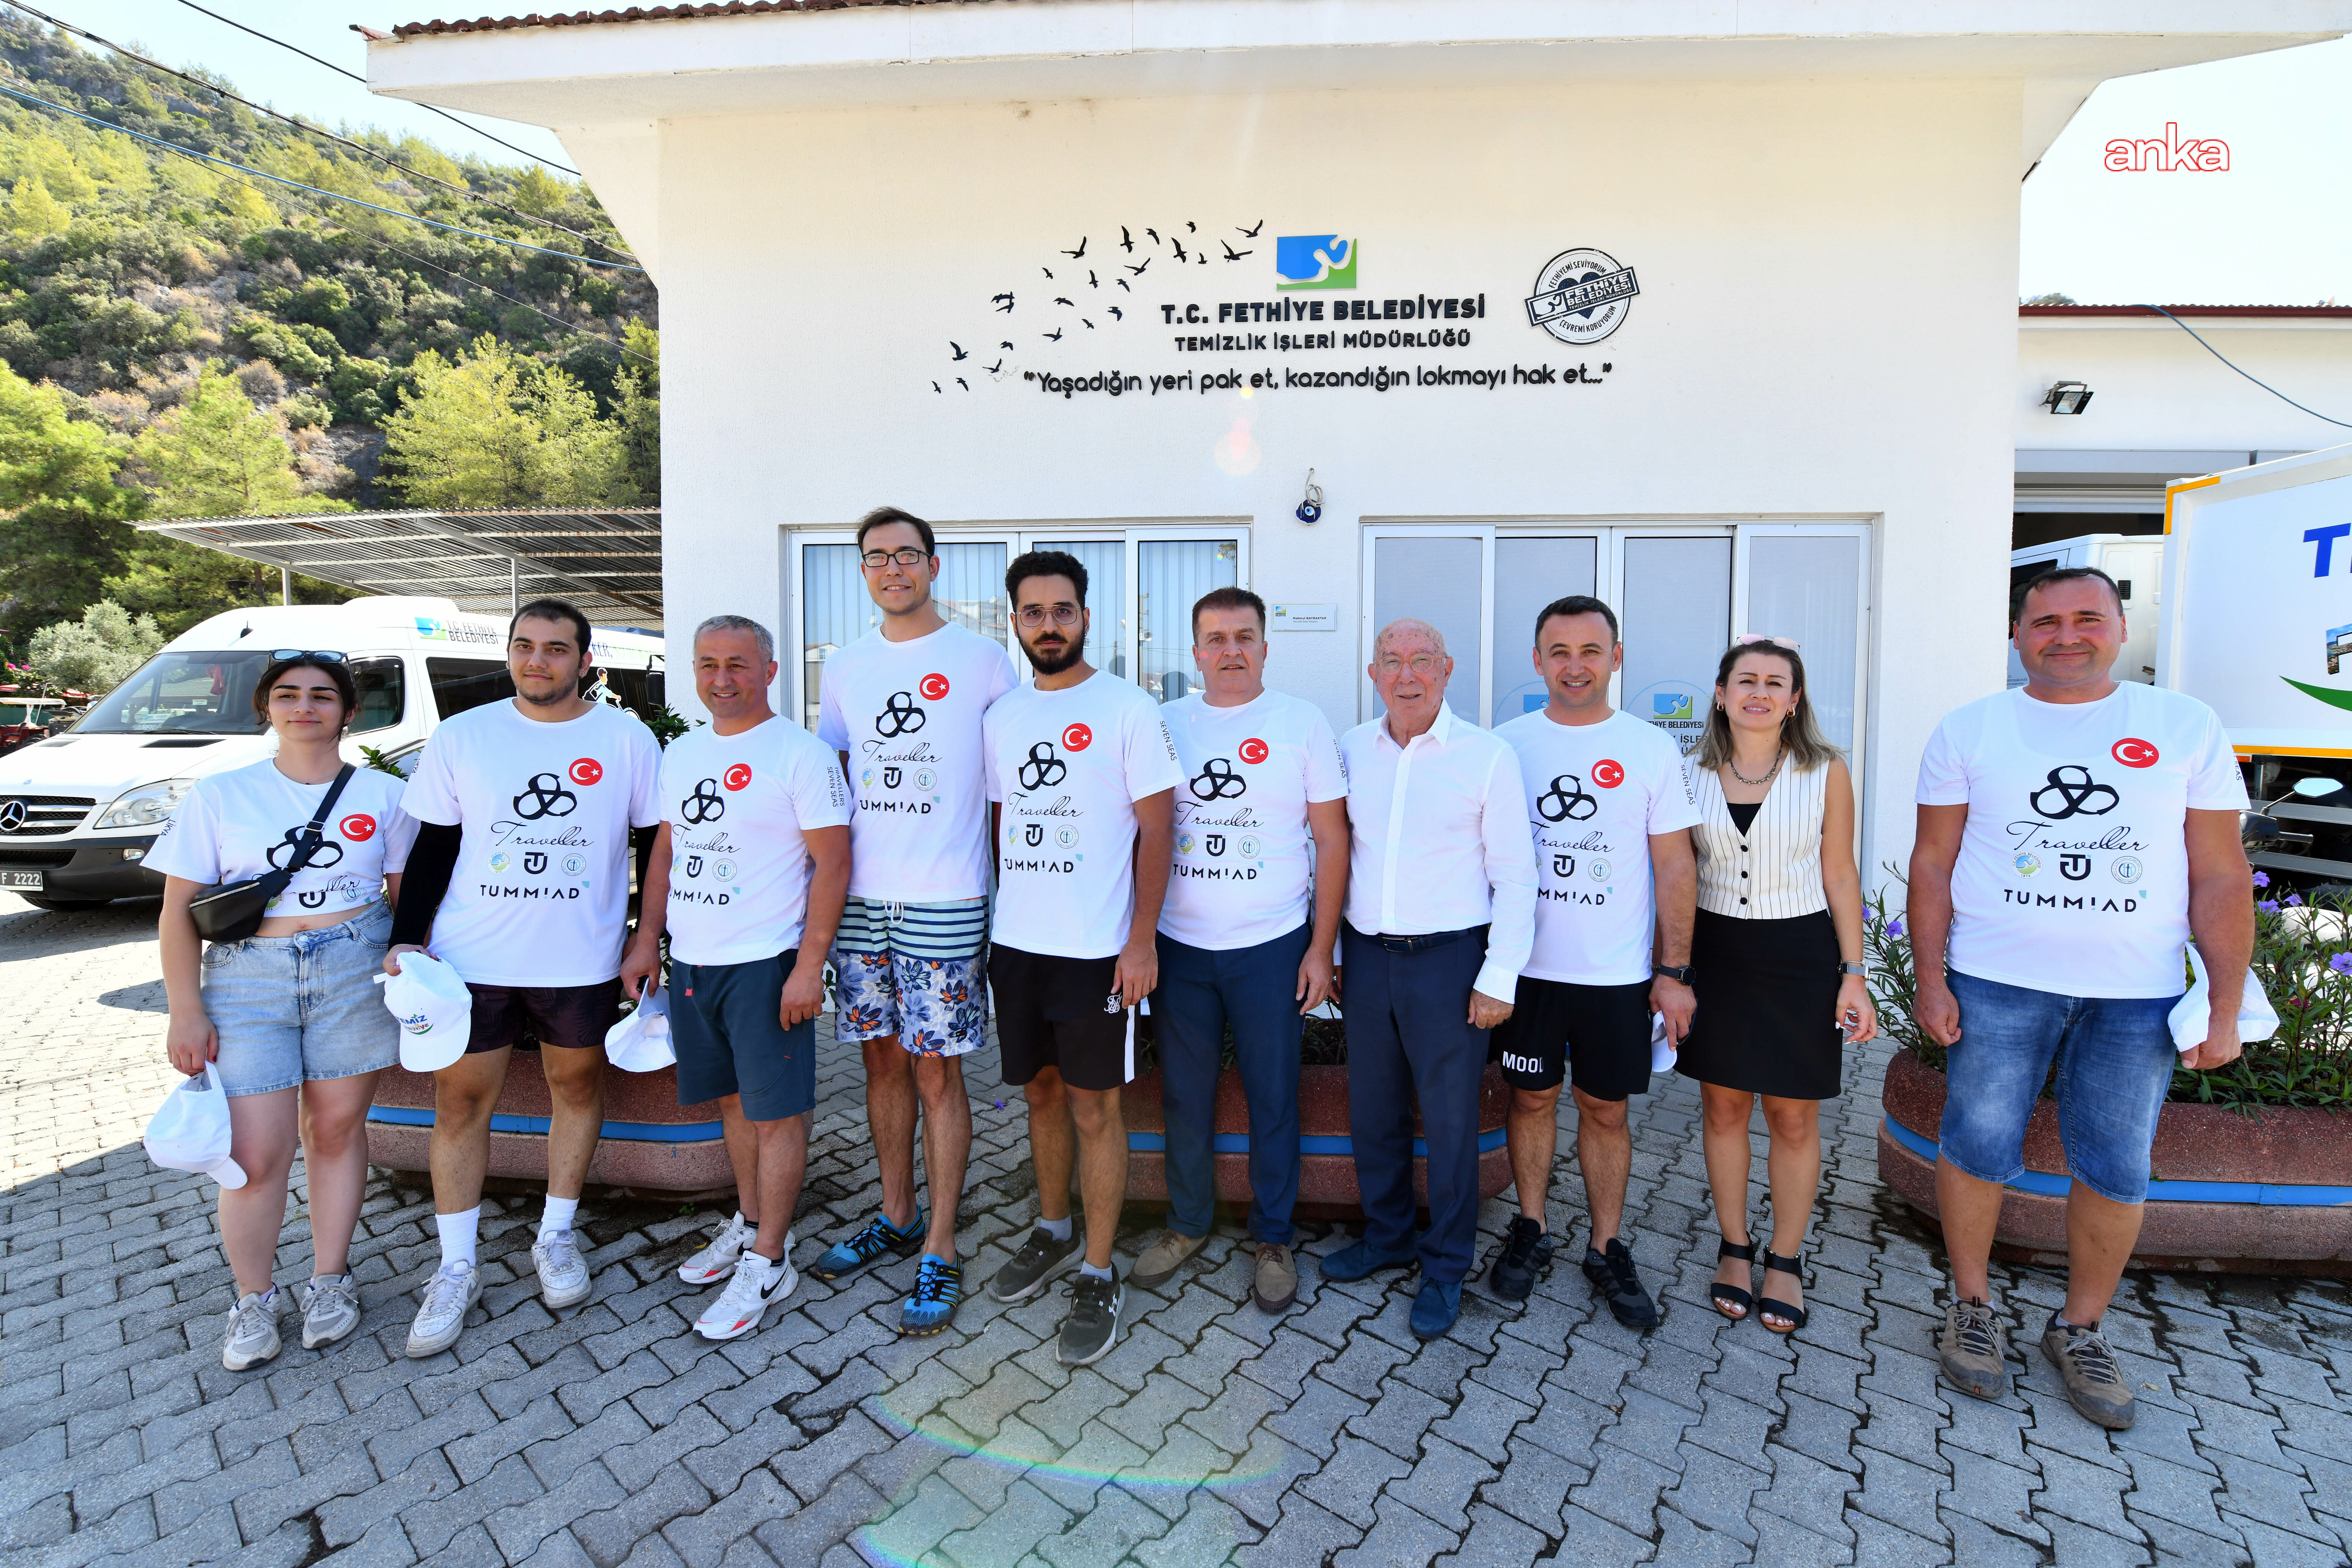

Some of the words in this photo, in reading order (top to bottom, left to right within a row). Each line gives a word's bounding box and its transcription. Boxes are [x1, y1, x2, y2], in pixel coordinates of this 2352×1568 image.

[1573, 259, 1607, 275] SEVİYORUM
[1161, 304, 1208, 324] T.C.
[1219, 297, 1324, 322] FETHİYE
[1334, 293, 1486, 320] BELEDİYESİ
[1587, 305, 1616, 332] KORUYORUM
[1174, 333, 1266, 351] TEMİZLİK
[1274, 330, 1336, 352] İŞLERİ
[1343, 328, 1471, 348] MÜDÜRLÜĞÜ
[1149, 370, 1192, 395] yeri
[1200, 368, 1242, 395] pak
[1250, 367, 1279, 389] et,
[1286, 365, 1410, 392] kazandığın
[1417, 364, 1506, 390] lokmayı
[1513, 363, 1556, 385] hak
[449, 631, 498, 644] BELEDİYESİ
[862, 740, 942, 764] Traveller
[1160, 721, 1171, 743] SEVEN
[1167, 744, 1177, 760] SEAS
[827, 767, 835, 788] SEVEN
[835, 767, 844, 806] TRAVELLERS
[1681, 765, 1690, 786] SEVEN
[1686, 789, 1695, 805] SEAS
[1008, 792, 1084, 817] Traveller
[1176, 801, 1264, 827] Traveller
[491, 821, 594, 846] Traveller
[672, 824, 741, 853] Traveller
[2006, 821, 2149, 850] Traveller
[2, 873, 7, 884] F
[14, 873, 41, 885] 2222
